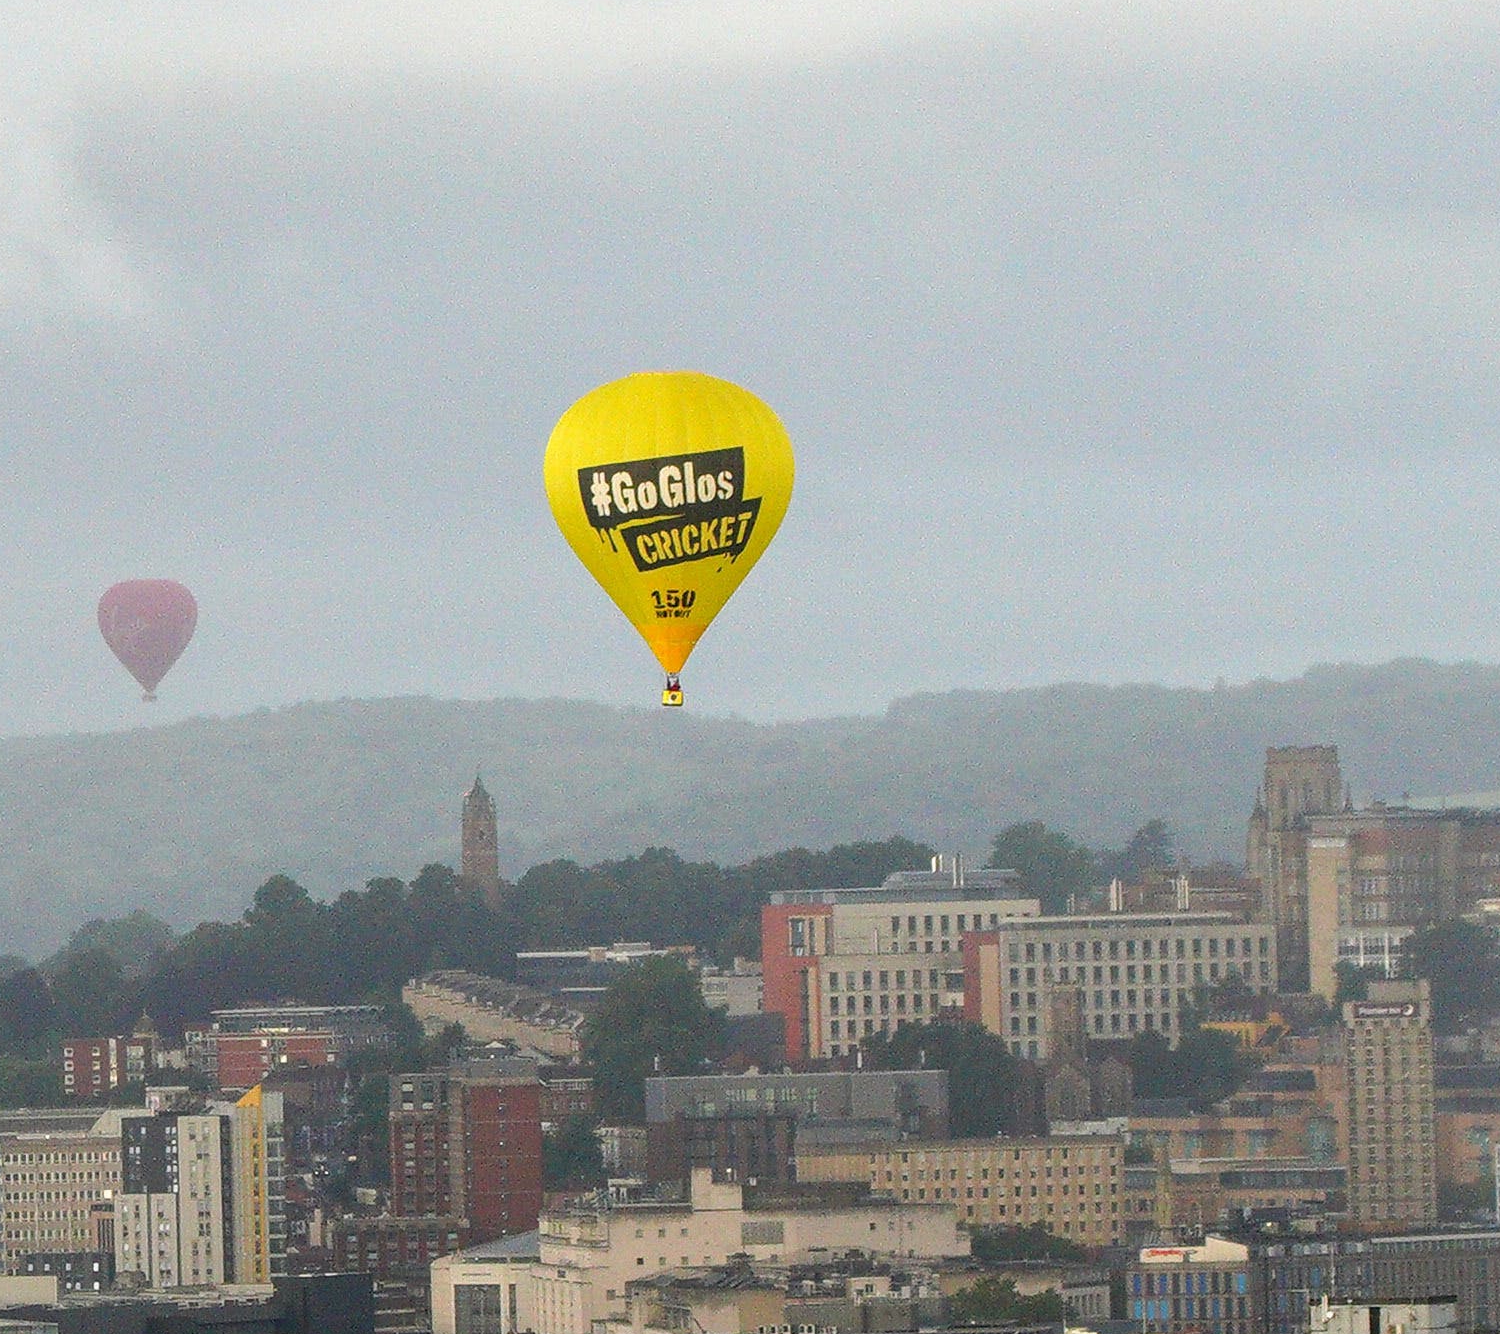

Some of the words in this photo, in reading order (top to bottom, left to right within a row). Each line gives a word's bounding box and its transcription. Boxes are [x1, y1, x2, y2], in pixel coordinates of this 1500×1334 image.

[590, 461, 735, 517] #GoGlos
[635, 512, 753, 565] CRICKET
[651, 589, 696, 609] 150
